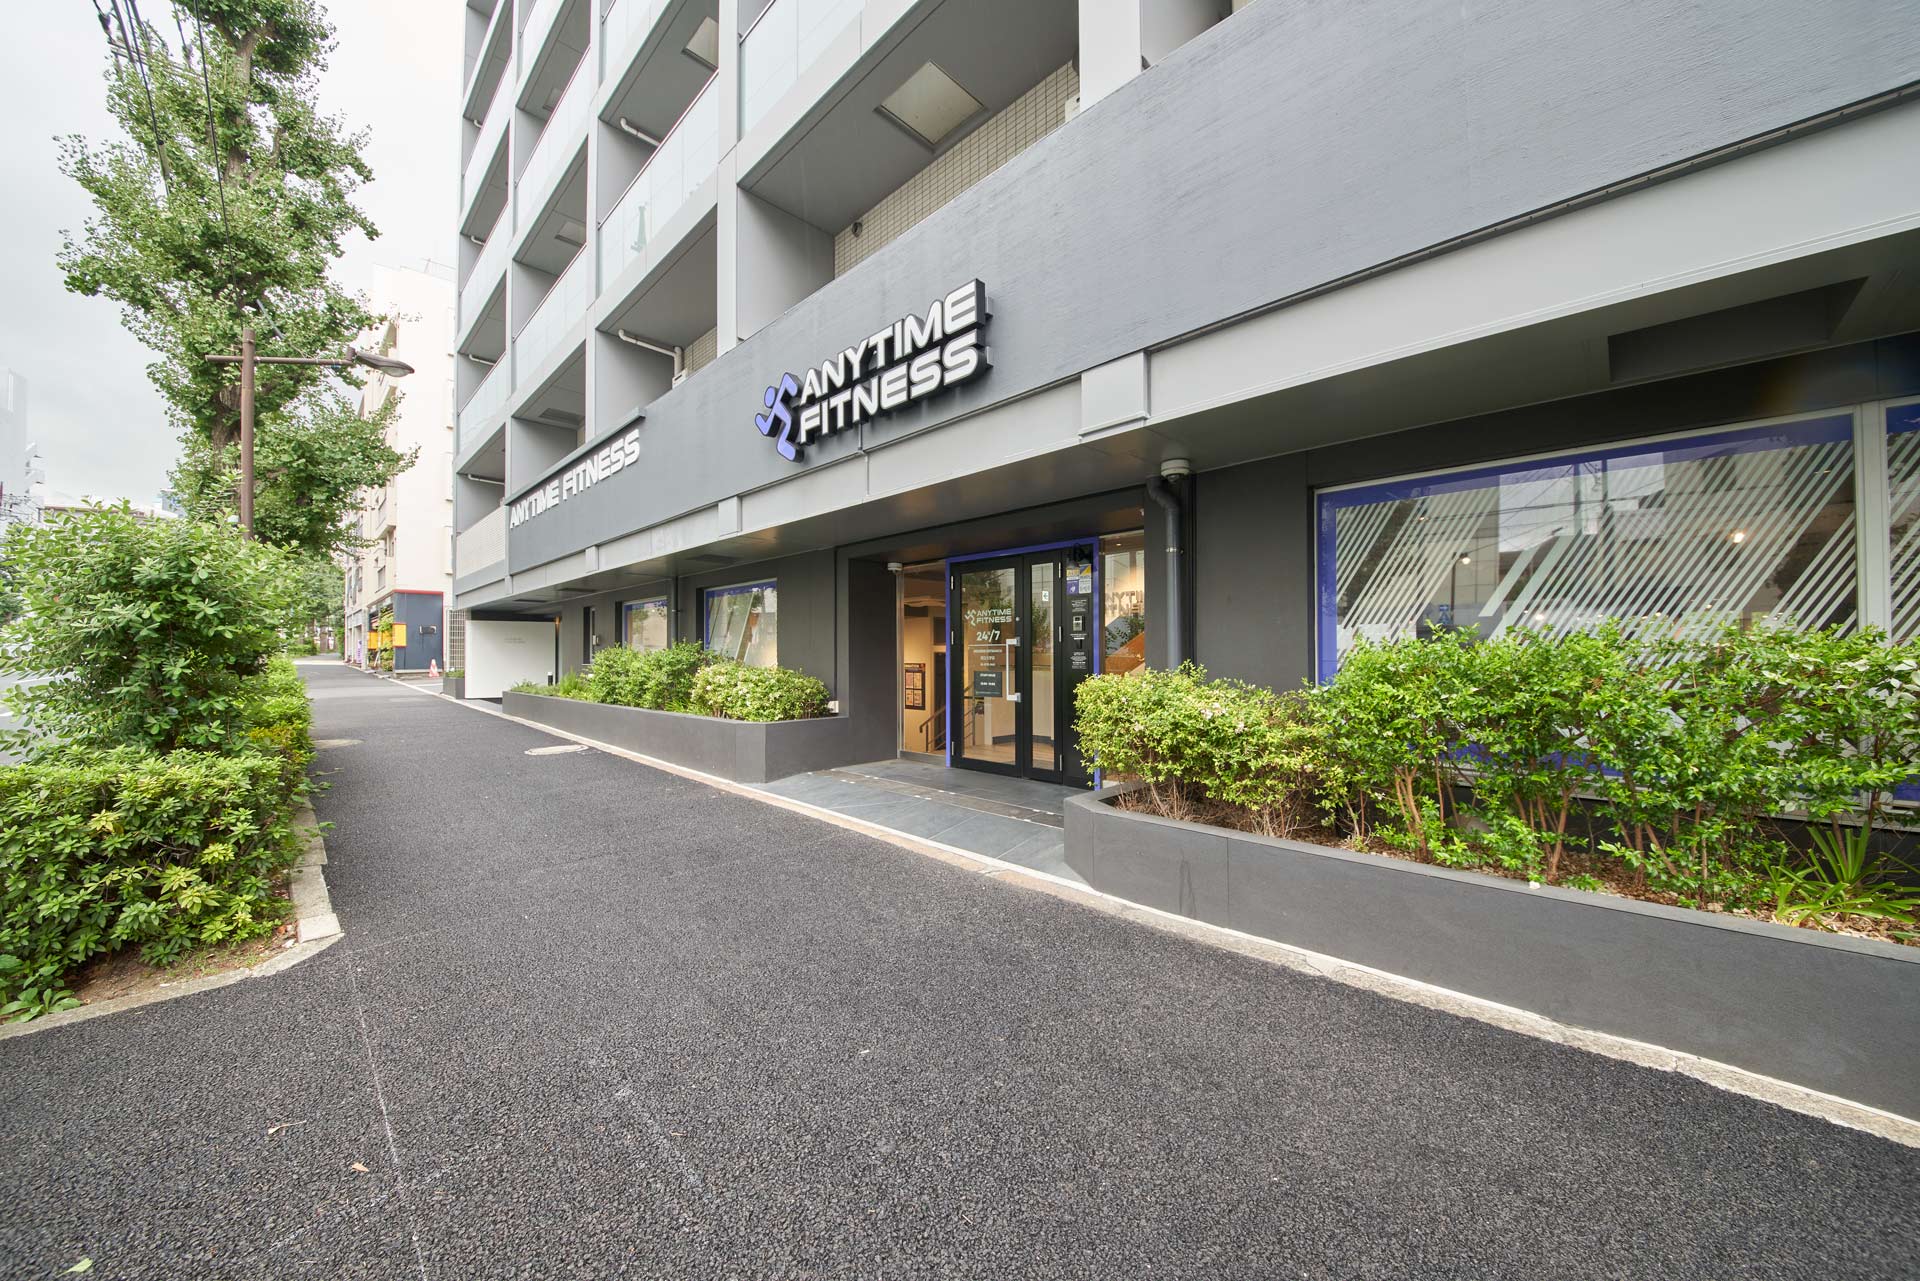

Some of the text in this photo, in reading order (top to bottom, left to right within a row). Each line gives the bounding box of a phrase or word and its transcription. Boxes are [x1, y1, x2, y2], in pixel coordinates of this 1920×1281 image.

[800, 328, 979, 443] FITNESS
[801, 279, 977, 405] ANYTIME
[510, 428, 640, 528] ANYTIME FITNESS
[976, 616, 1012, 624] FITNESS
[977, 608, 1012, 616] ANYTIME
